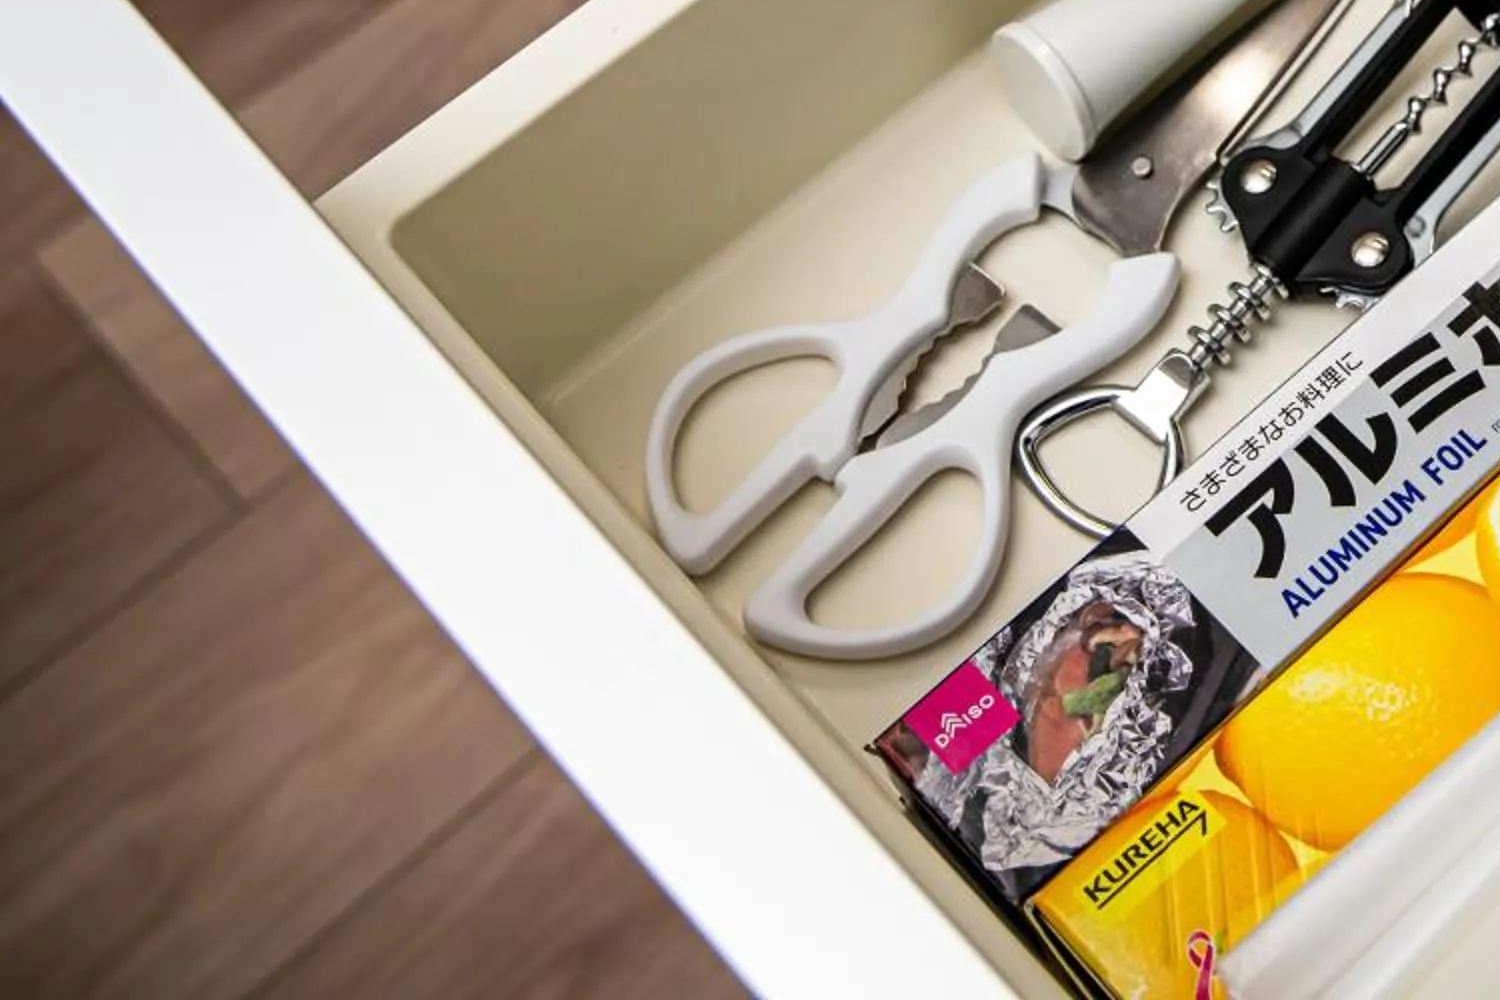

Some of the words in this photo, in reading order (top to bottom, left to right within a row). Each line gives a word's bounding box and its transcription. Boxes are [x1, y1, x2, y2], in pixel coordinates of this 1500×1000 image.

[1179, 351, 1364, 512] さまざまなお料理に
[1280, 479, 1427, 620] ALUMINUM
[1420, 428, 1488, 487] FOIL
[1082, 799, 1201, 904] KUREHA
